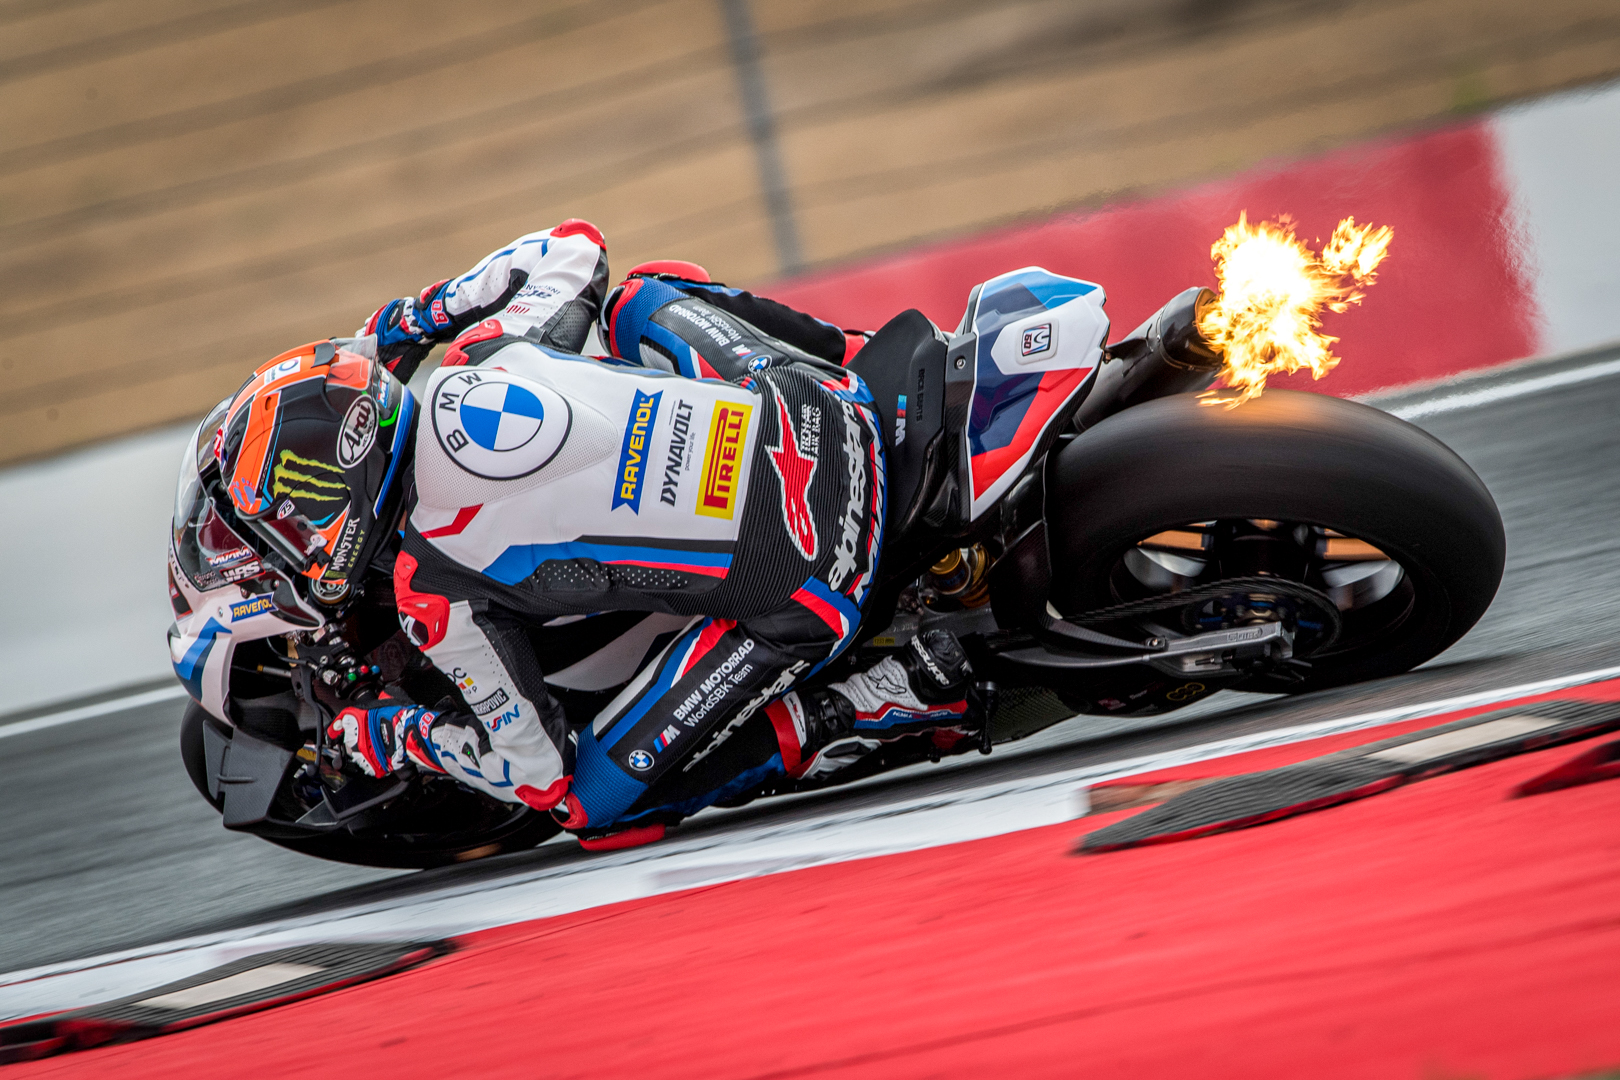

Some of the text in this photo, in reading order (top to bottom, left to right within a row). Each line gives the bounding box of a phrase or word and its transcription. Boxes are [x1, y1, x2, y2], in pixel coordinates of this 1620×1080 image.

[706, 327, 730, 347] BMW
[347, 399, 372, 463] Arai
[620, 397, 655, 500] RAVENOL
[660, 399, 694, 507] DYNAVOLT
[703, 407, 744, 509] PIRELLI
[828, 400, 866, 592] alpinestars
[331, 517, 360, 571] MONSTER
[347, 529, 365, 568] ENERGY
[233, 598, 273, 619] RAVENOL
[673, 638, 755, 721] BMW MOTORRAD
[684, 663, 753, 728] WorldSBK Team
[419, 712, 435, 739] 60
